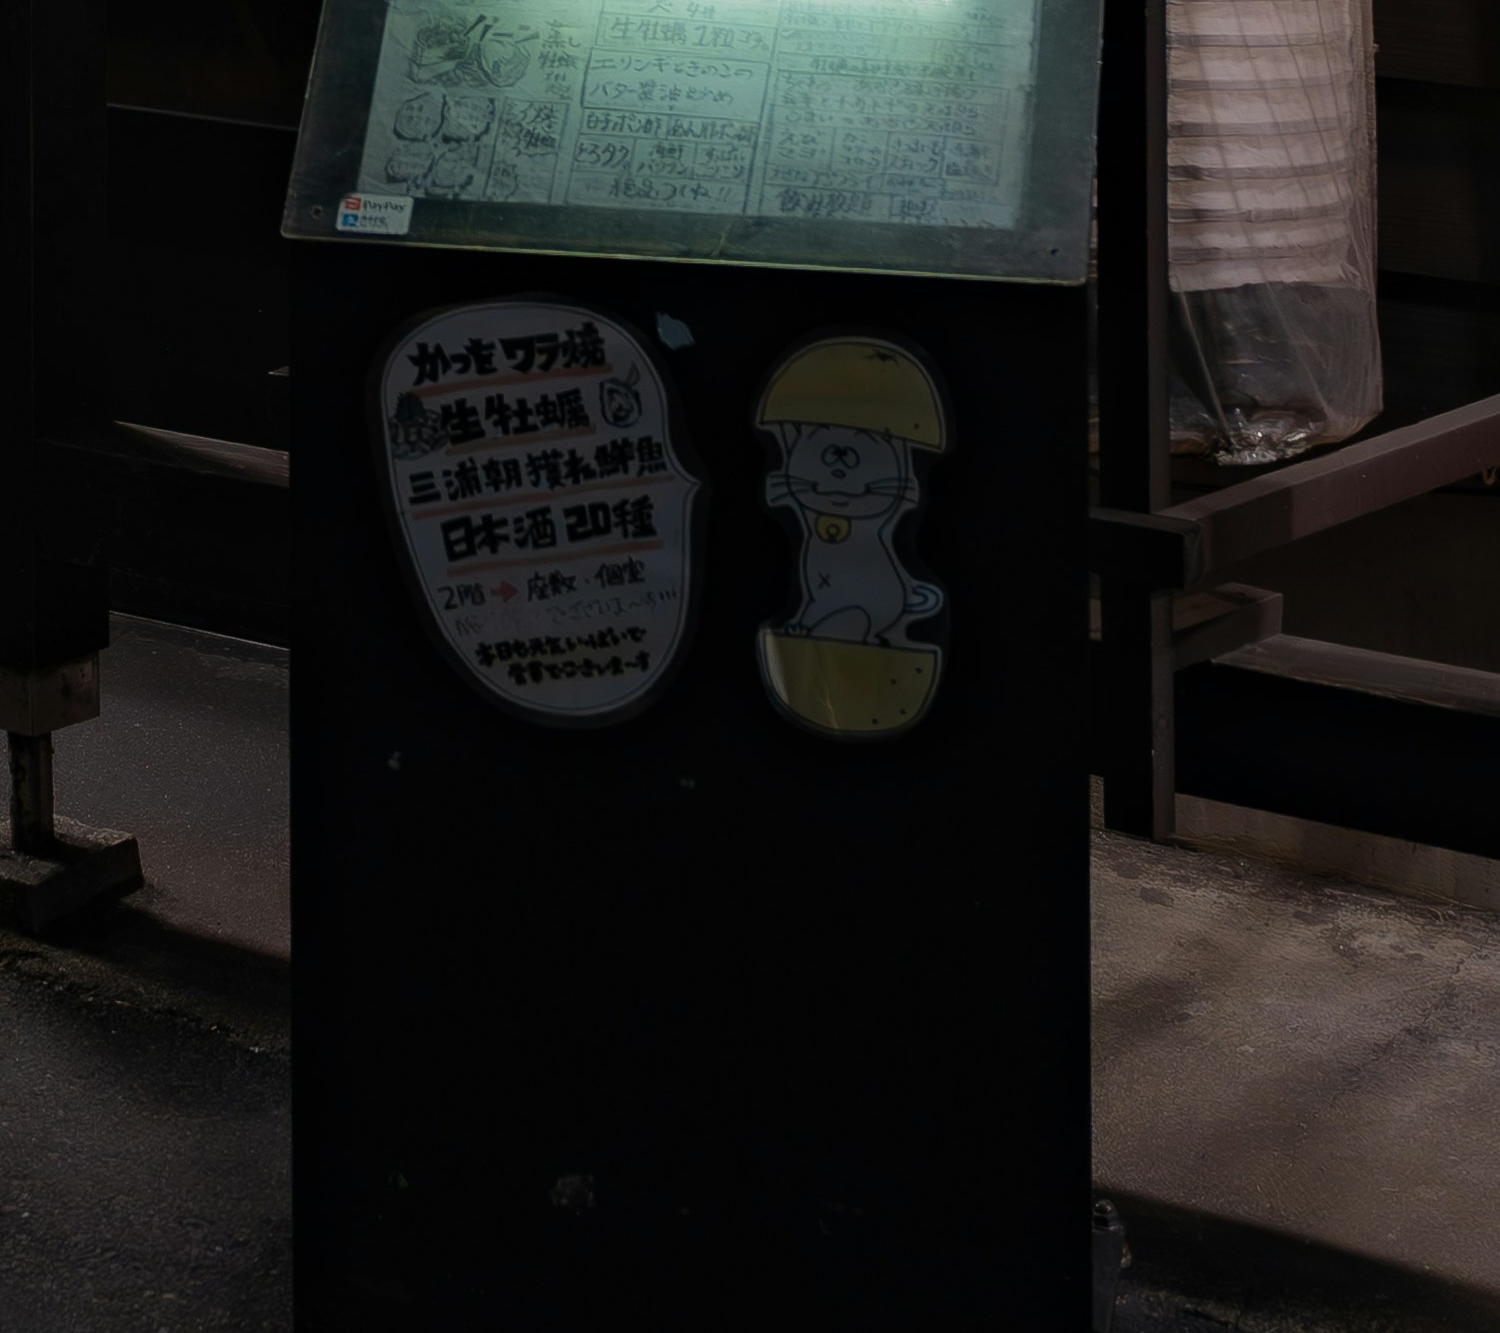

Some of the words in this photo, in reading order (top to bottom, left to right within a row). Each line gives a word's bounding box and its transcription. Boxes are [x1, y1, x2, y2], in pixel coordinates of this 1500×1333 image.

[408, 435, 668, 505] 三浦朝獲れ鮮魚
